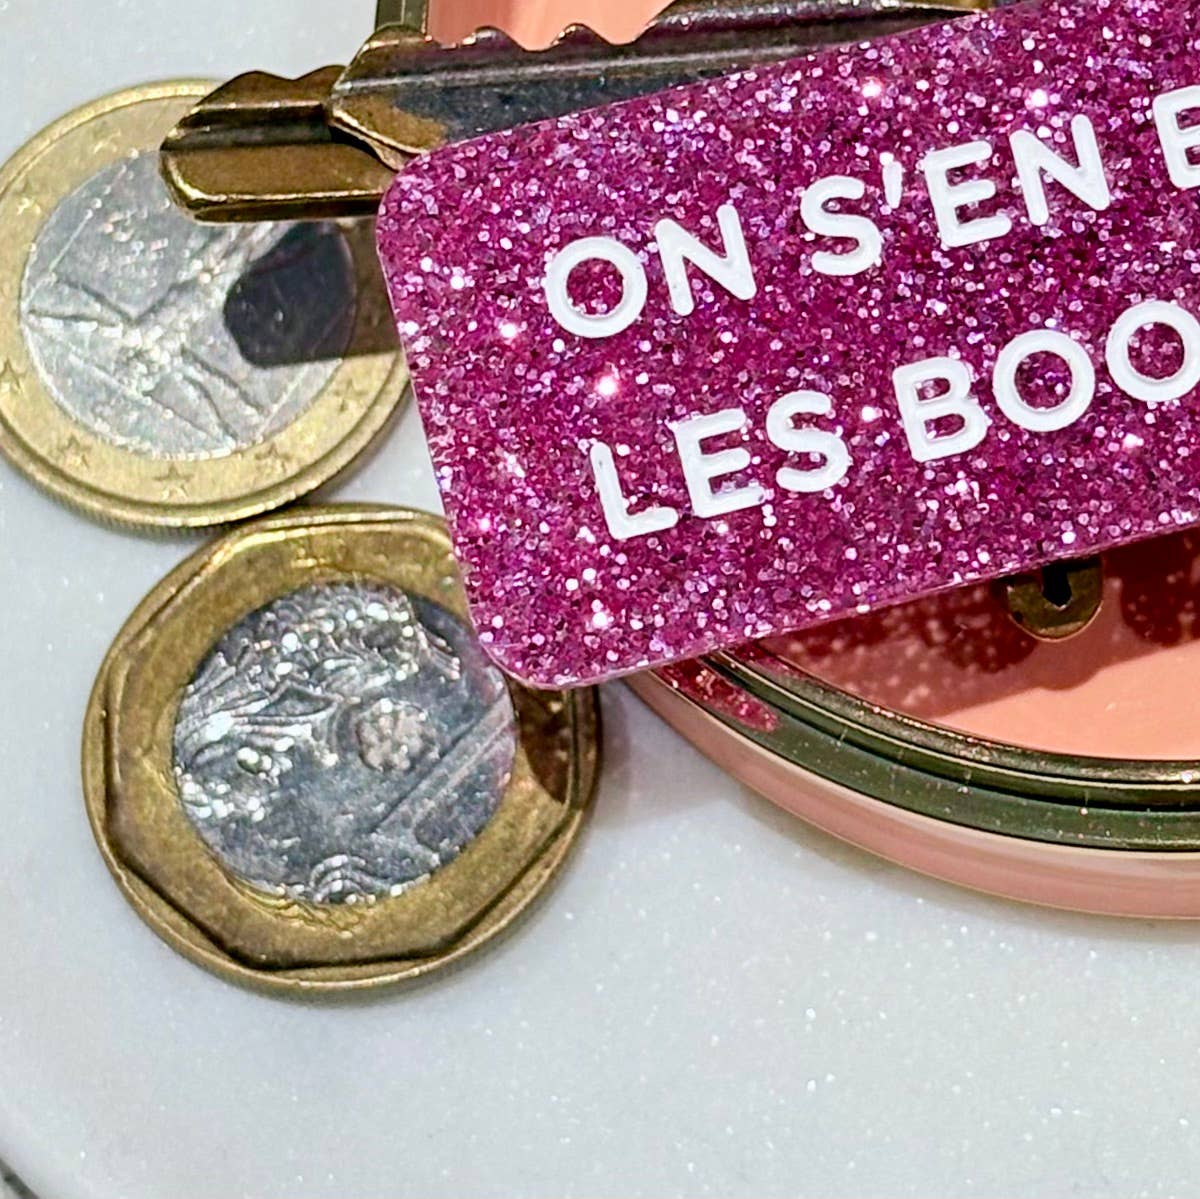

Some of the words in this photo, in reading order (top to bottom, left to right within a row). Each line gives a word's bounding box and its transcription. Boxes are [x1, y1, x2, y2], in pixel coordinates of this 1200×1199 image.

[540, 200, 757, 338] ON
[798, 114, 1115, 276] S'EN
[590, 390, 853, 540] LES
